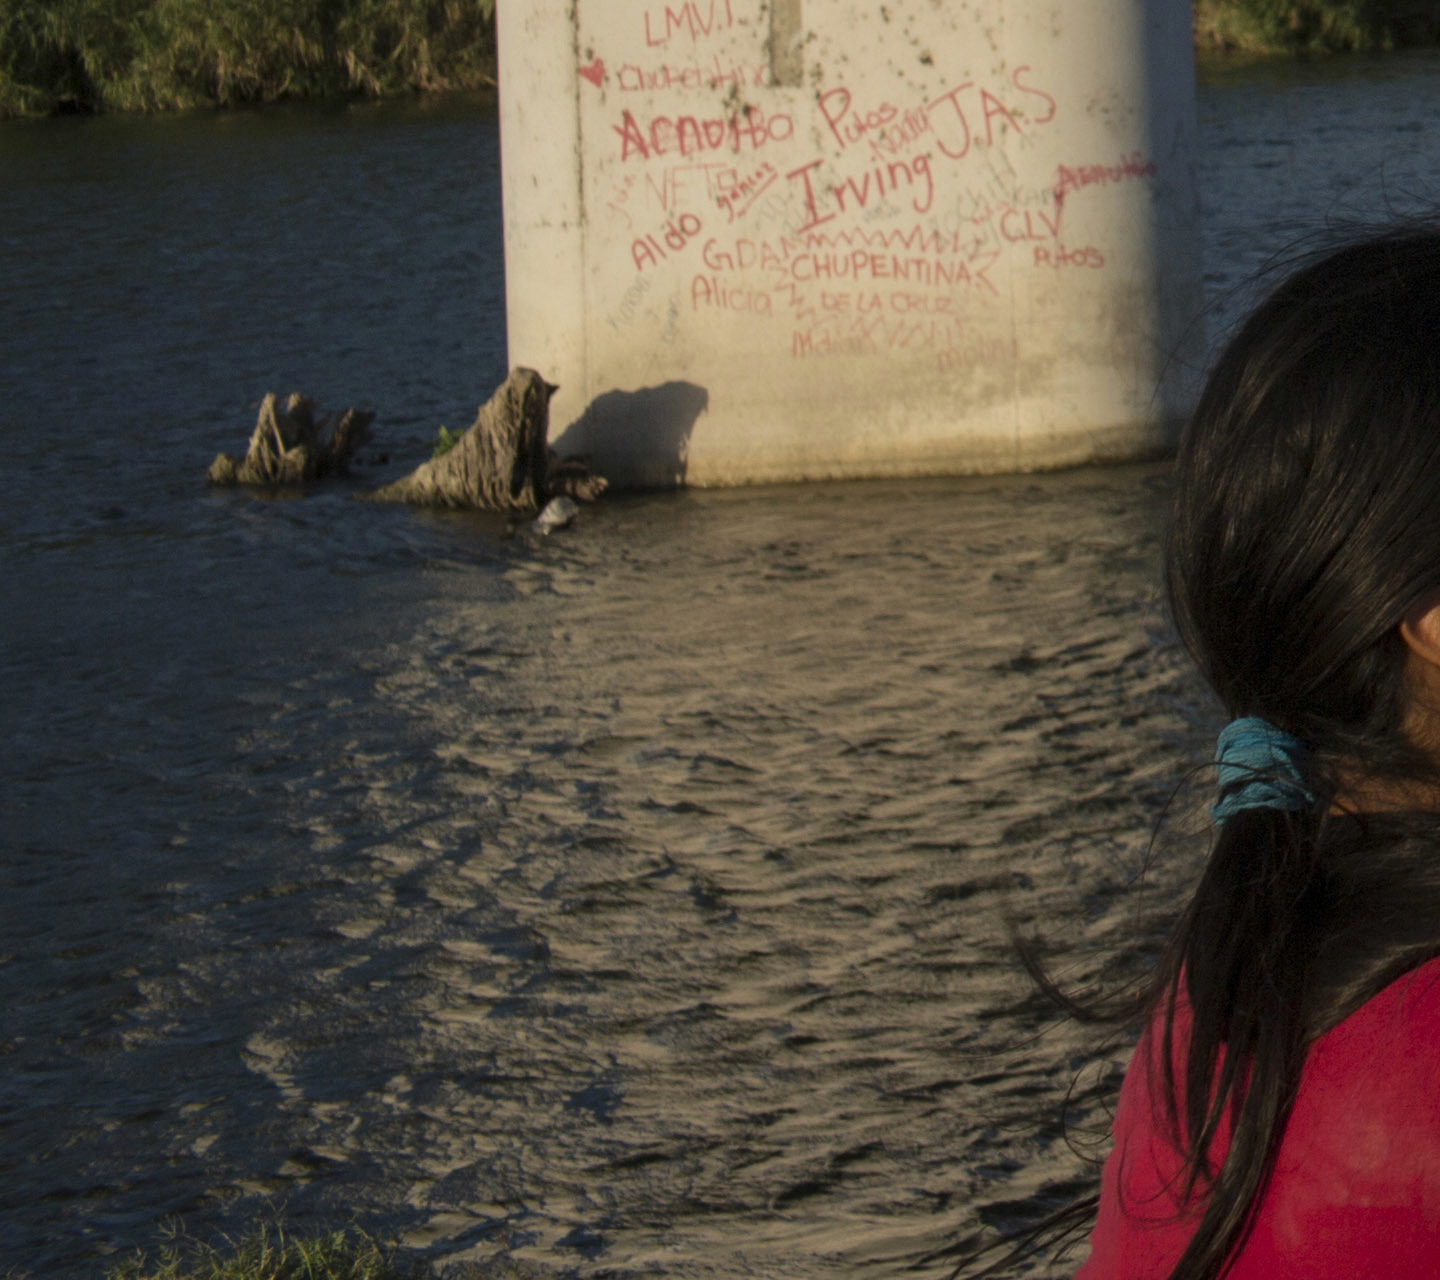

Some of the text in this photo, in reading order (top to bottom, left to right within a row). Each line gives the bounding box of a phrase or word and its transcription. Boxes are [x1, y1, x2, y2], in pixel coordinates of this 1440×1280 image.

[786, 154, 934, 235] Irving
[631, 213, 703, 272] Aldo
[791, 248, 972, 289] CHUPENTINA
[691, 274, 774, 320] Alicia
[856, 292, 883, 314] LA
